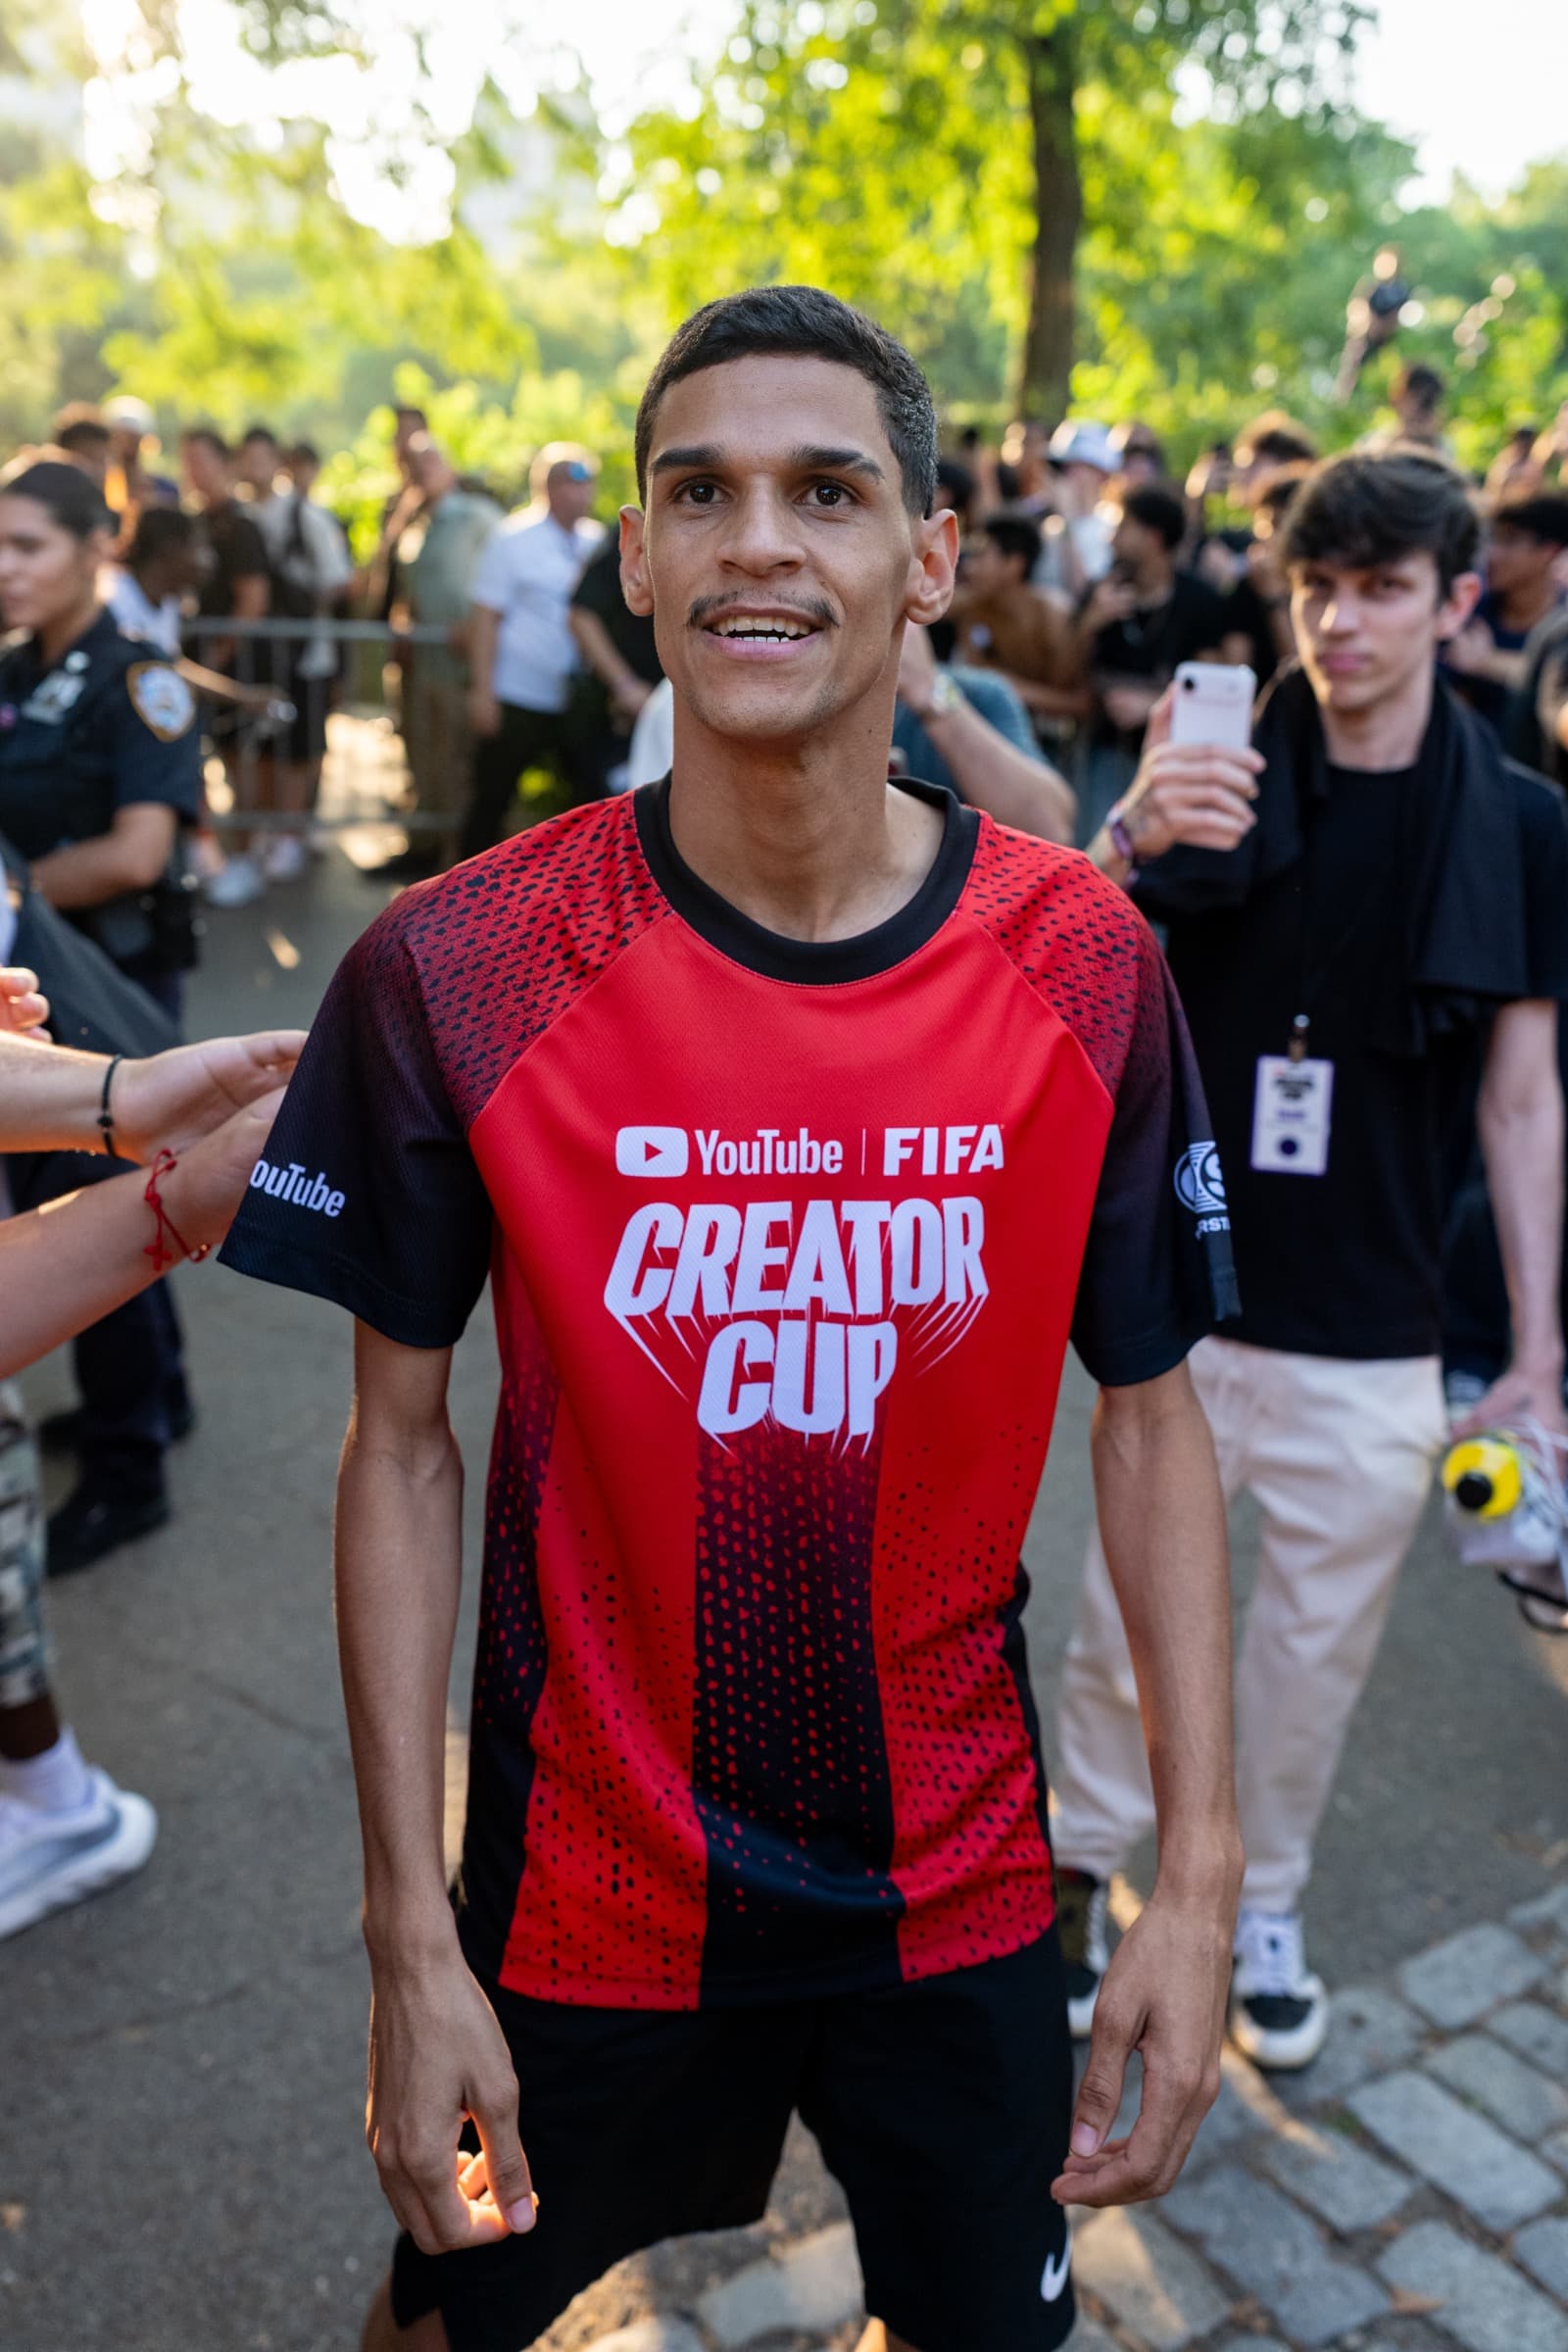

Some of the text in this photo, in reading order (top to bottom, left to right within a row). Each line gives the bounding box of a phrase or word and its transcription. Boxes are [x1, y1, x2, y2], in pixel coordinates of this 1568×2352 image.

[249, 1159, 346, 1217] ouTube
[694, 1124, 1004, 1176] YouTube FIFA
[604, 1196, 990, 1317] CREATOR
[697, 1319, 898, 1436] CUP
